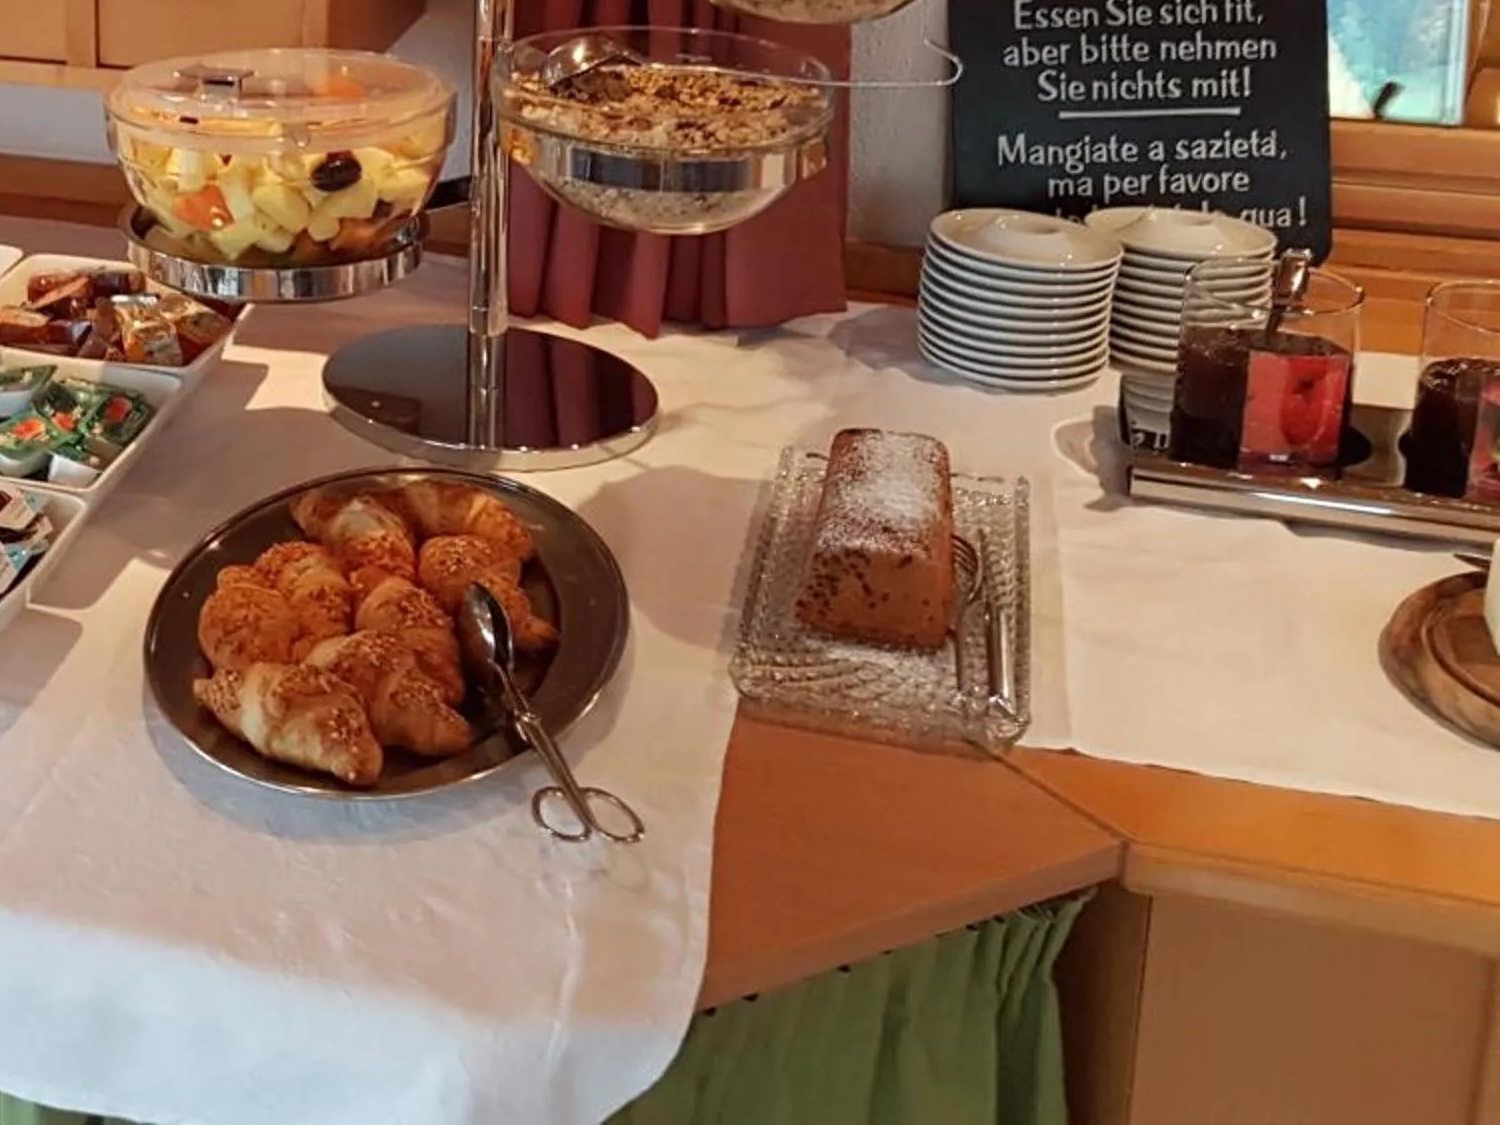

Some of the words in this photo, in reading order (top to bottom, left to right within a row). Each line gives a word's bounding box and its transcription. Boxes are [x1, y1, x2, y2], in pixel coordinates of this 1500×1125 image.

[1003, 37, 1072, 67] aber
[1081, 35, 1150, 63] bitte
[1159, 31, 1277, 61] nehmen
[1037, 69, 1086, 103] Sie
[1092, 71, 1182, 101] nichts
[1191, 65, 1252, 99] mit!
[998, 132, 1138, 175] Mangiate
[1148, 140, 1165, 163] a
[1048, 176, 1093, 197] ma
[1103, 172, 1152, 203] per
[1158, 163, 1251, 194] favore
